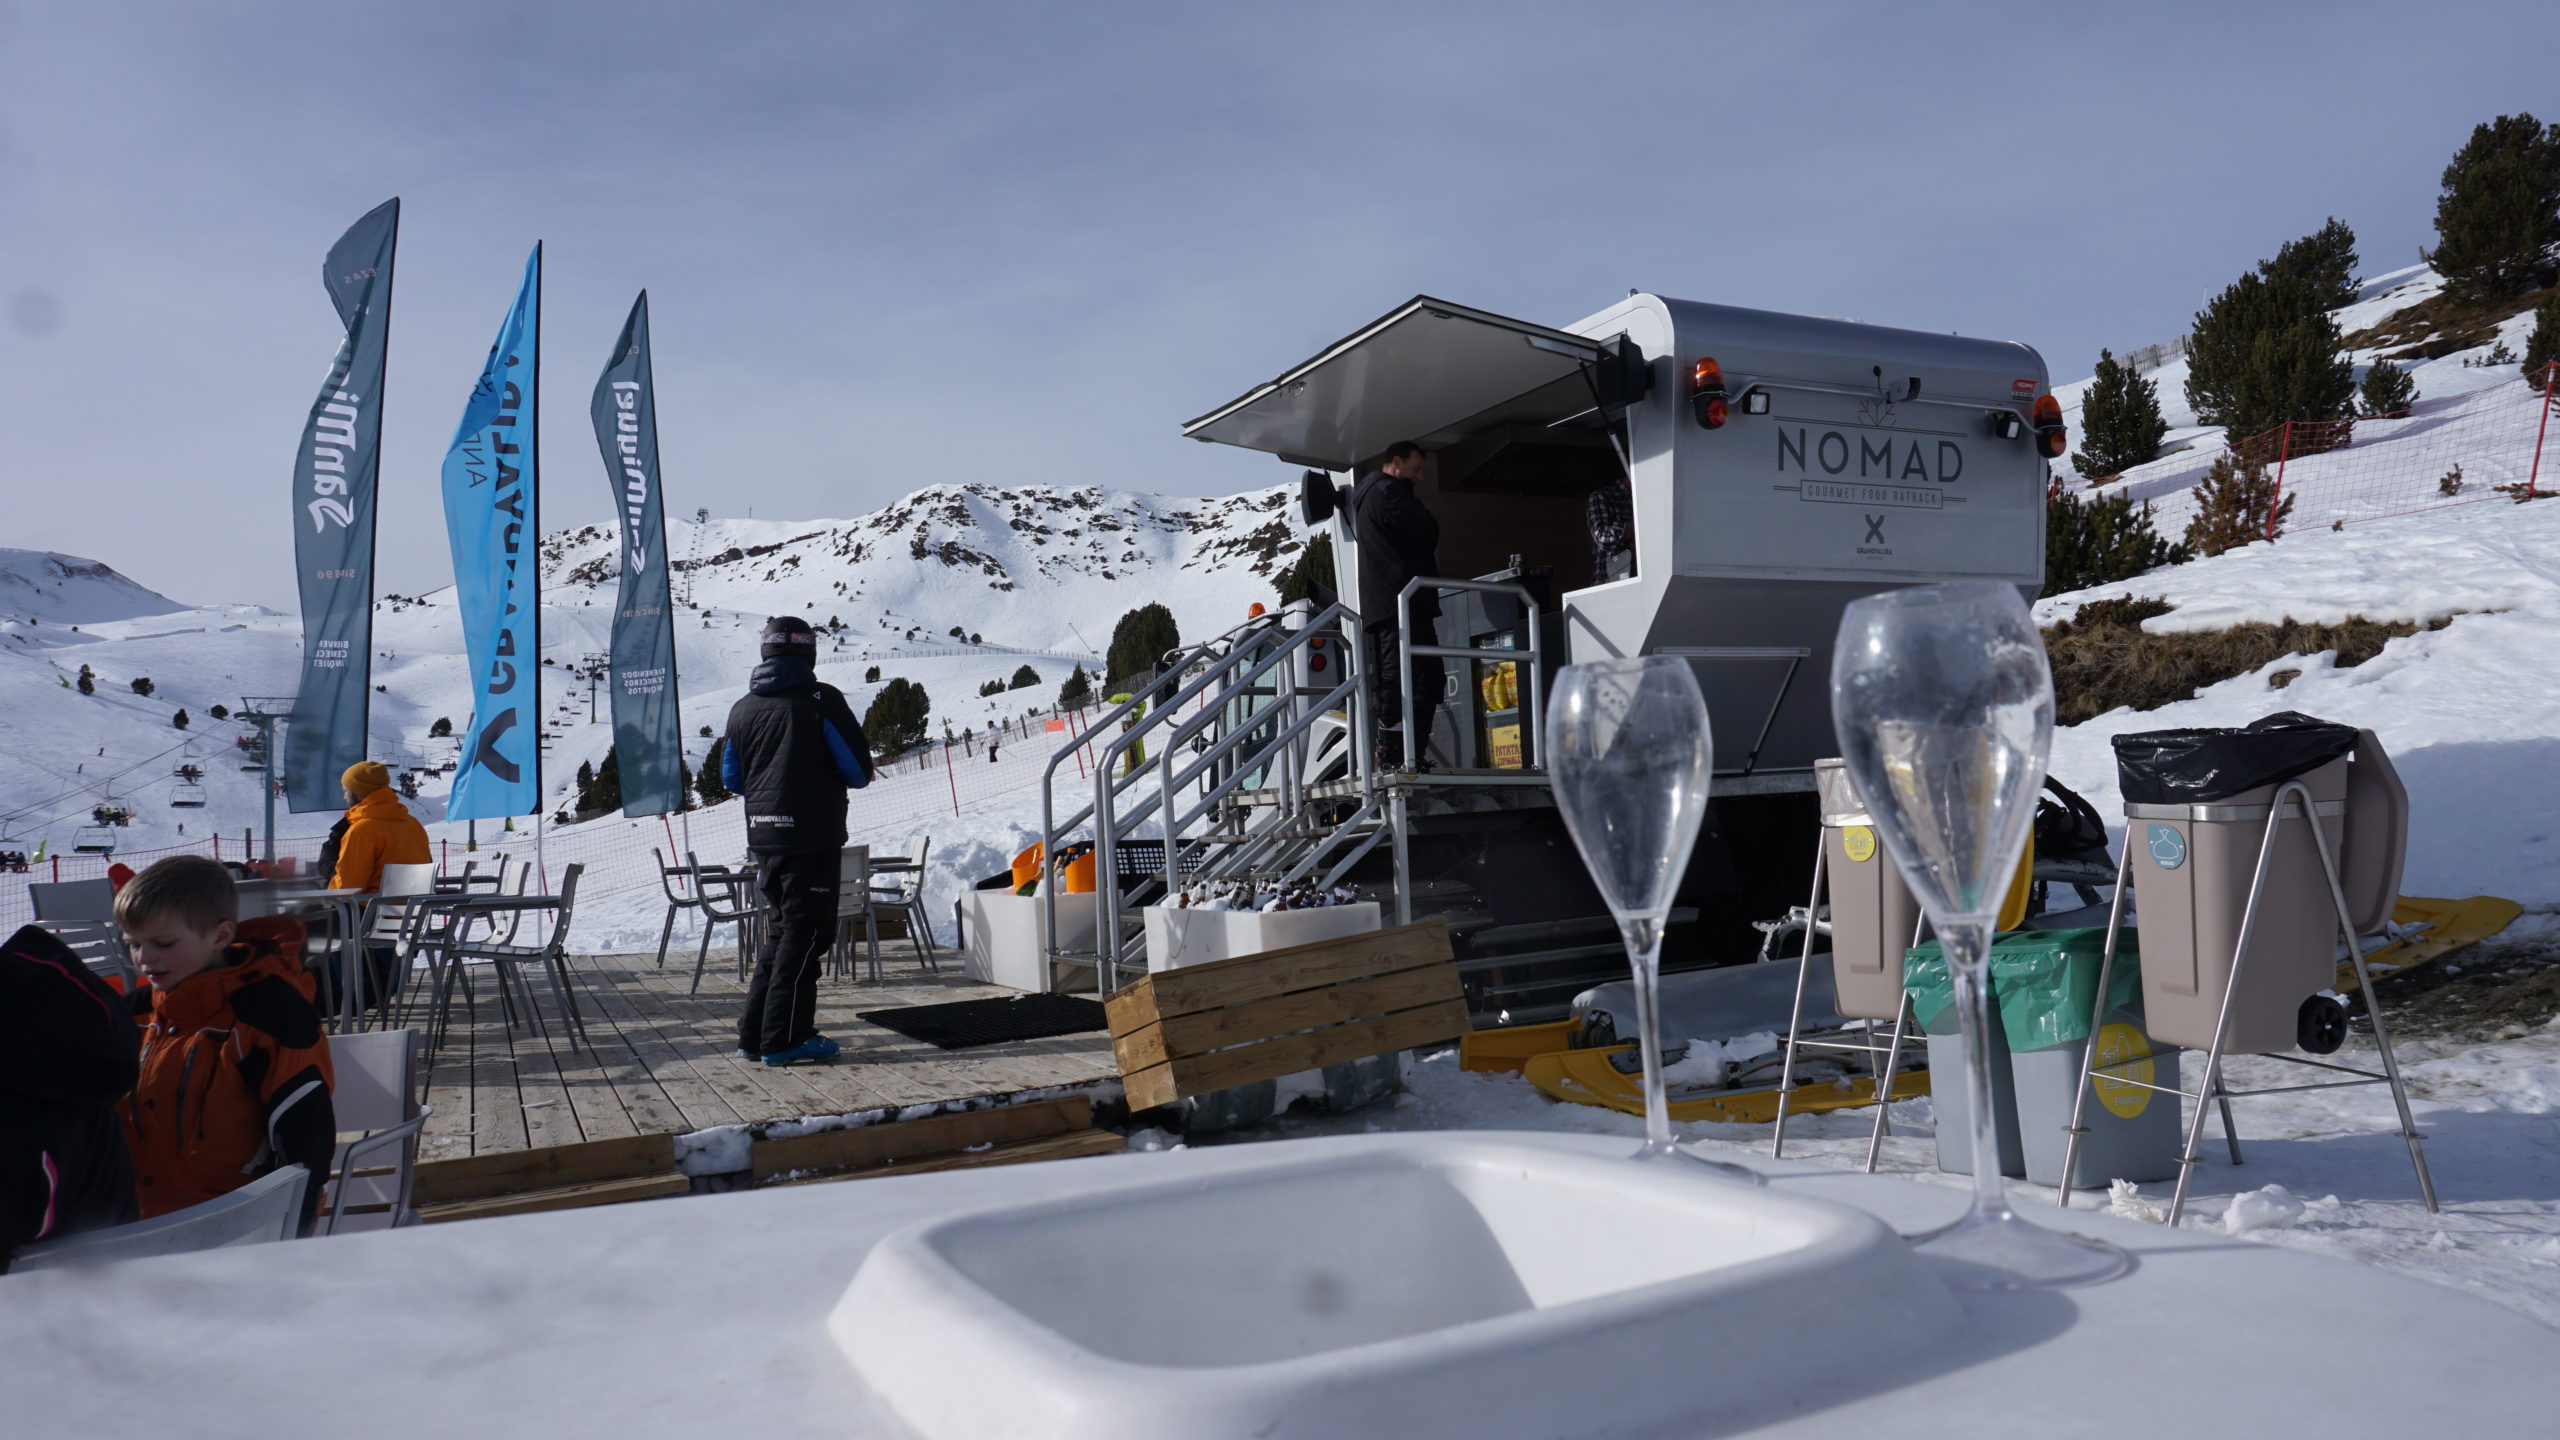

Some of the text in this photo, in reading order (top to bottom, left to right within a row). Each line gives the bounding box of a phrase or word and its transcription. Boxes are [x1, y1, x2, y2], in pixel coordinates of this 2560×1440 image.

[1778, 426, 1963, 483] NOMAD
[1807, 485, 1937, 504] GOURMET FOOD RATRACK
[1495, 744, 1520, 756] PATATA
